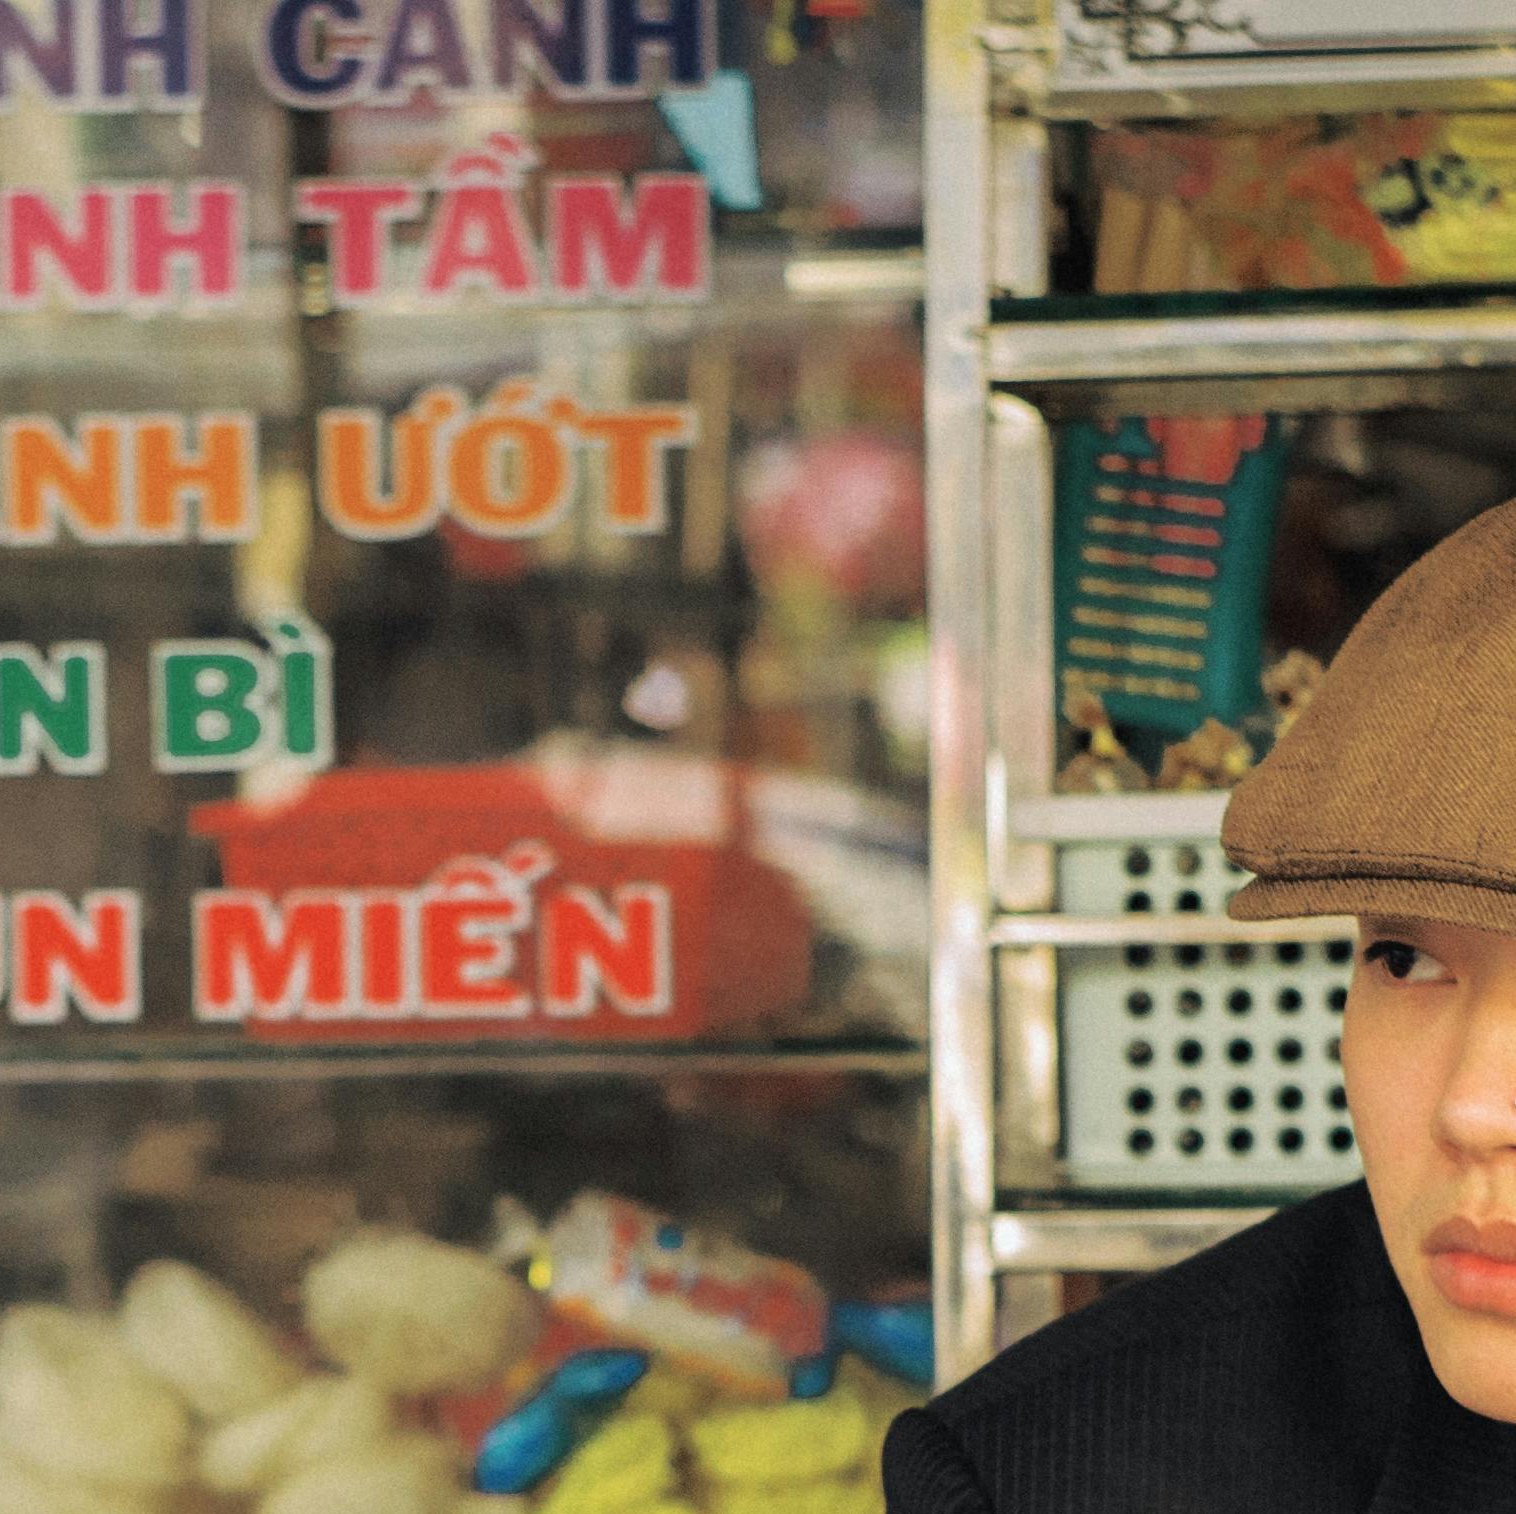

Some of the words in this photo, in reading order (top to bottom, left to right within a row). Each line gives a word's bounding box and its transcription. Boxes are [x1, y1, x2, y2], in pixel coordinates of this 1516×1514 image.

[319, 380, 687, 538] ƯỚT
[153, 618, 329, 768] BÌ
[197, 842, 669, 1018] MIẾN
